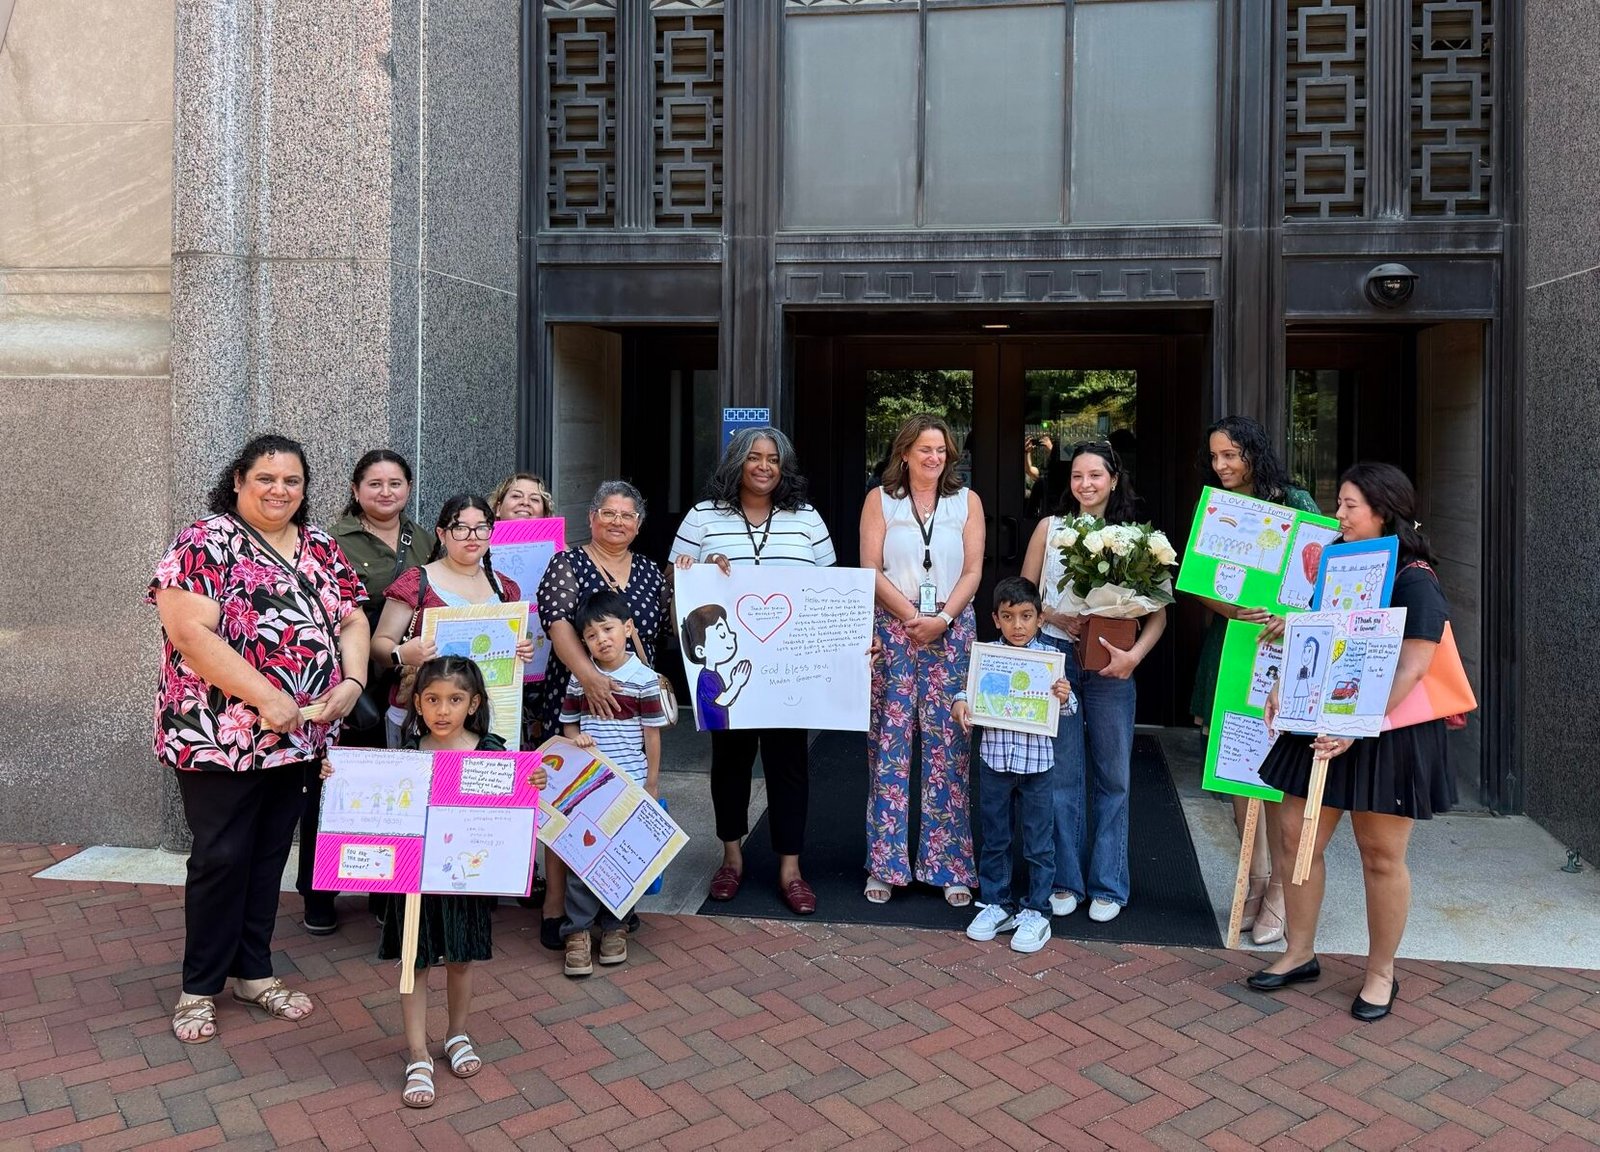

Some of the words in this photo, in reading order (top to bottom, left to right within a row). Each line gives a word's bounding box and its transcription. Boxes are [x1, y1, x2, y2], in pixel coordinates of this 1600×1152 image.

[1220, 495, 1246, 506] LOVE
[1251, 502, 1265, 511] MY
[760, 663, 779, 675] God
[784, 663, 810, 675] bless
[465, 759, 484, 767] Thank
